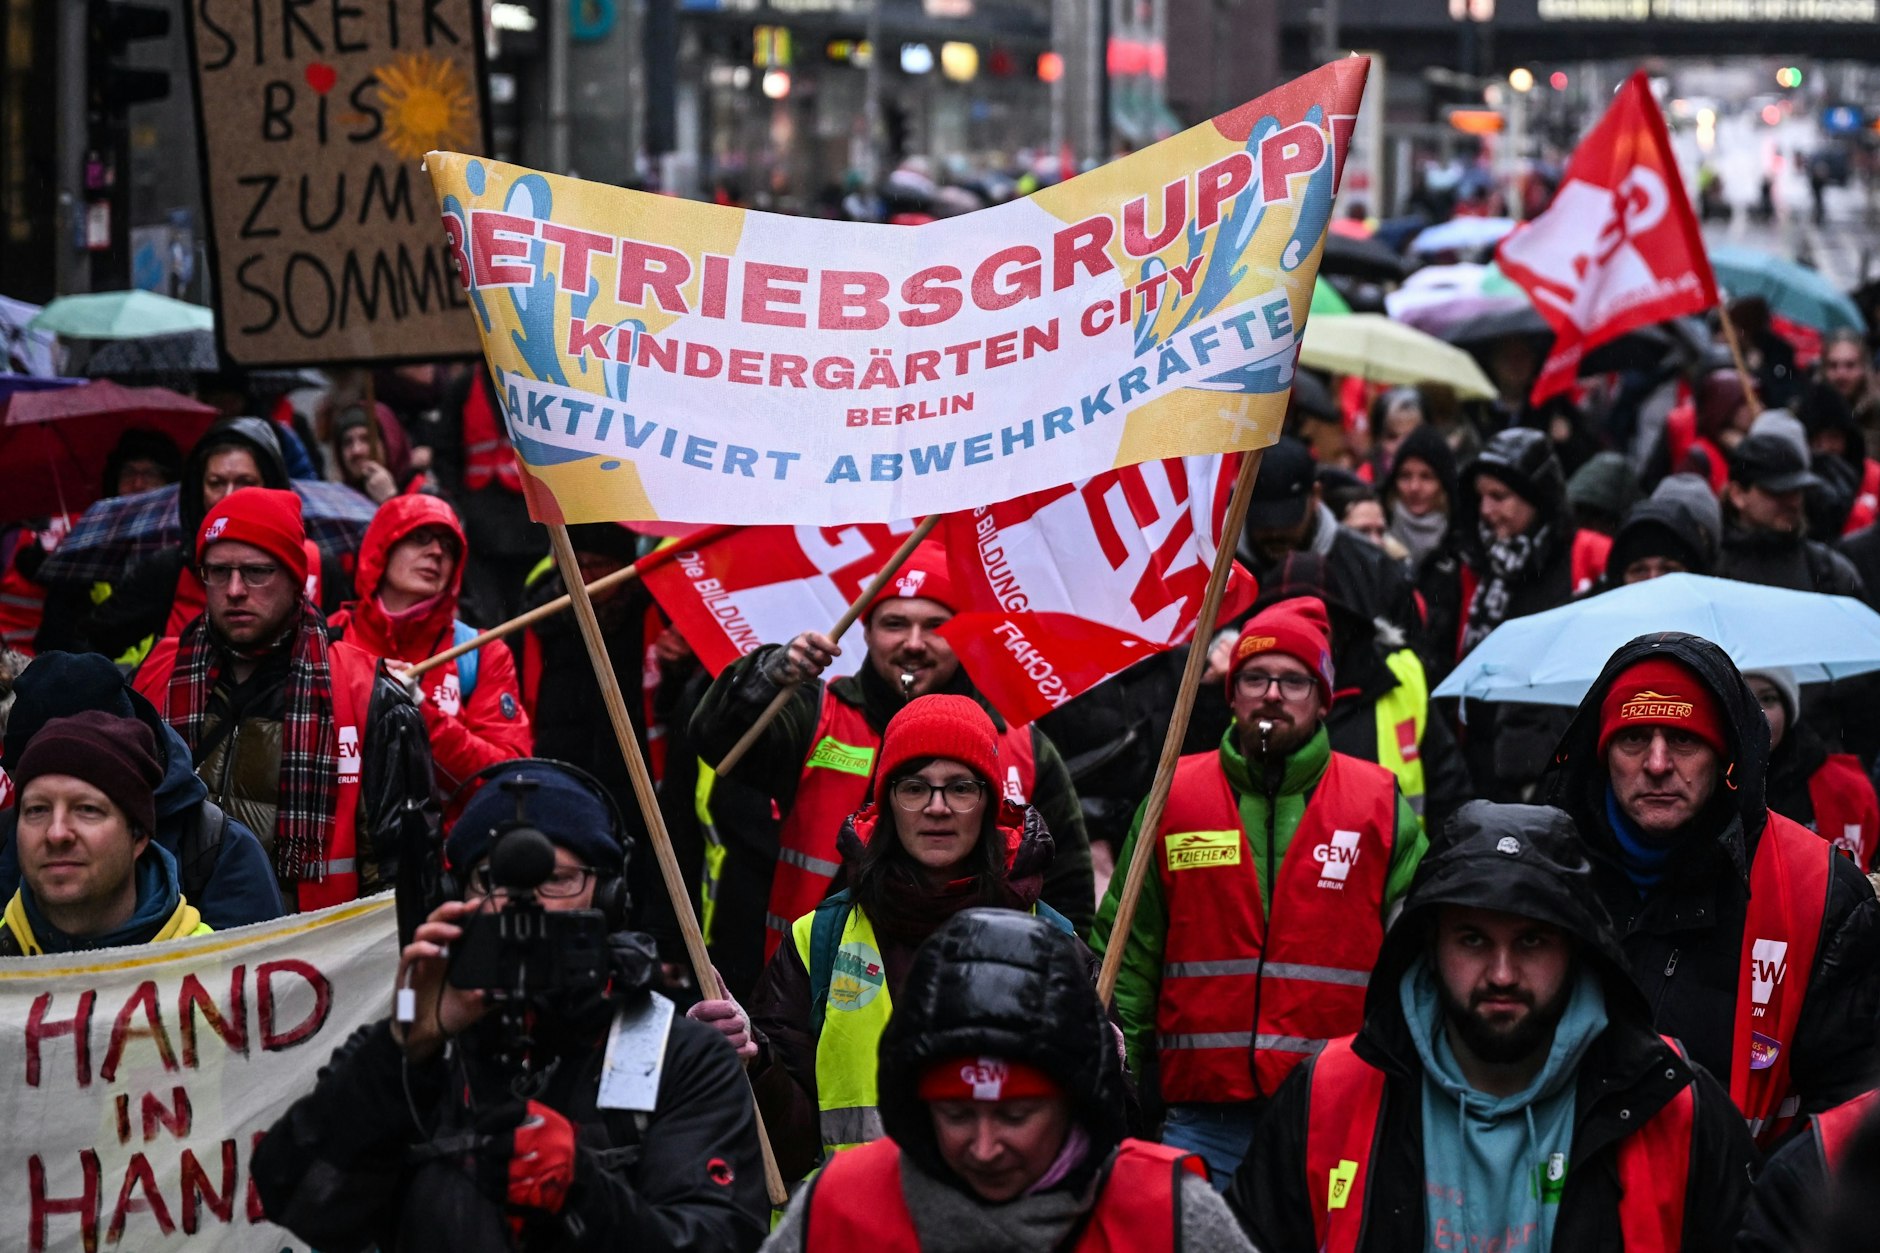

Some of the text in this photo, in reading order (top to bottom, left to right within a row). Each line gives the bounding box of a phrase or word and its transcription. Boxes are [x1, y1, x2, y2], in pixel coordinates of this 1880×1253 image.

[238, 163, 416, 239] ZUM
[567, 255, 1204, 391] KINDERGÄRTEN CITY
[508, 297, 1293, 484] AKTIVIERT ABWEHRKRÄFTE
[845, 392, 975, 428] BERLIN
[676, 551, 704, 578] Die
[1621, 703, 1683, 718] ERZIEHER
[1313, 843, 1360, 866] GEW
[1317, 879, 1344, 890] BERLIN
[25, 959, 333, 1088] HAND
[115, 1085, 192, 1146] IN
[27, 1130, 268, 1253] HAN
